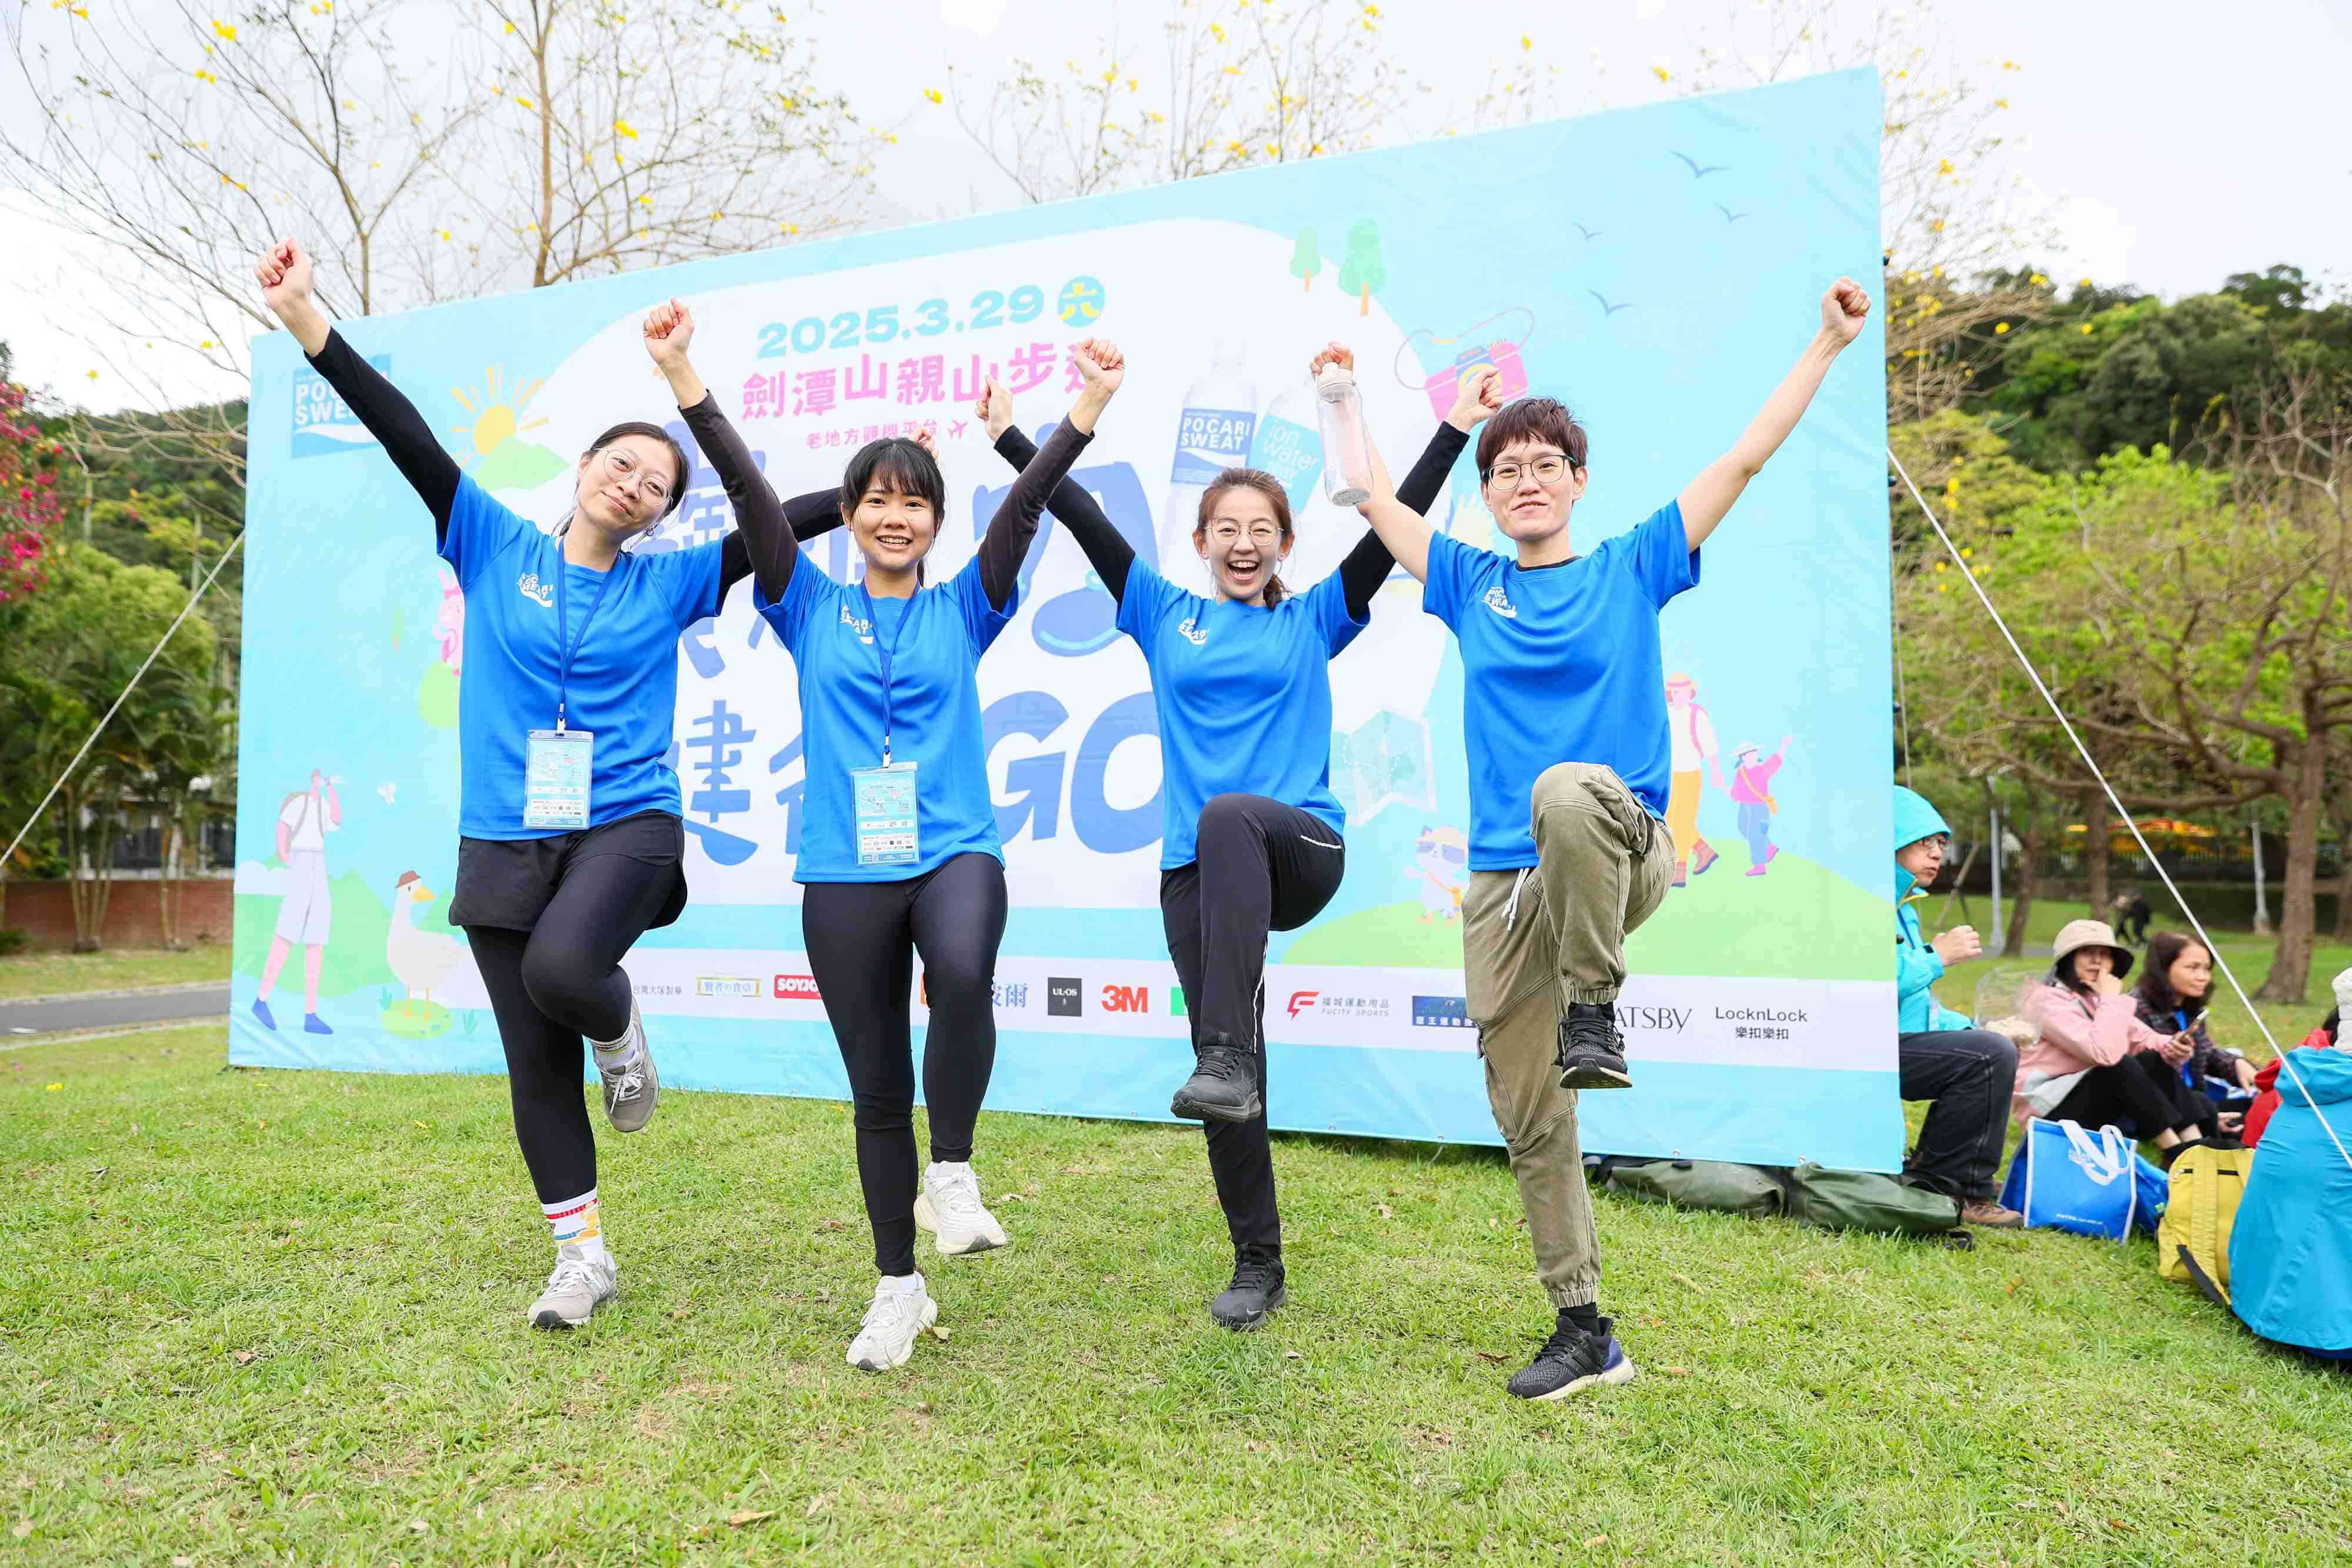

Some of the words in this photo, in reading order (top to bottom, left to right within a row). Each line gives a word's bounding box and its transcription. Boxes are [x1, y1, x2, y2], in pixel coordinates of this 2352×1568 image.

[1058, 283, 1100, 320] 六
[757, 284, 1044, 359] 2025.3.29
[295, 399, 356, 424] SWE
[1182, 417, 1251, 436] POCARI
[1269, 423, 1299, 446] ion
[1180, 432, 1244, 451] SWEAT
[1263, 440, 1320, 471] water
[777, 977, 819, 992] SOYJO
[1101, 985, 1148, 1013] 3M
[1615, 1006, 1693, 1034] ATSBY
[1715, 1007, 1809, 1023] LocknLock
[1735, 1026, 1789, 1041] 樂扣樂扣
